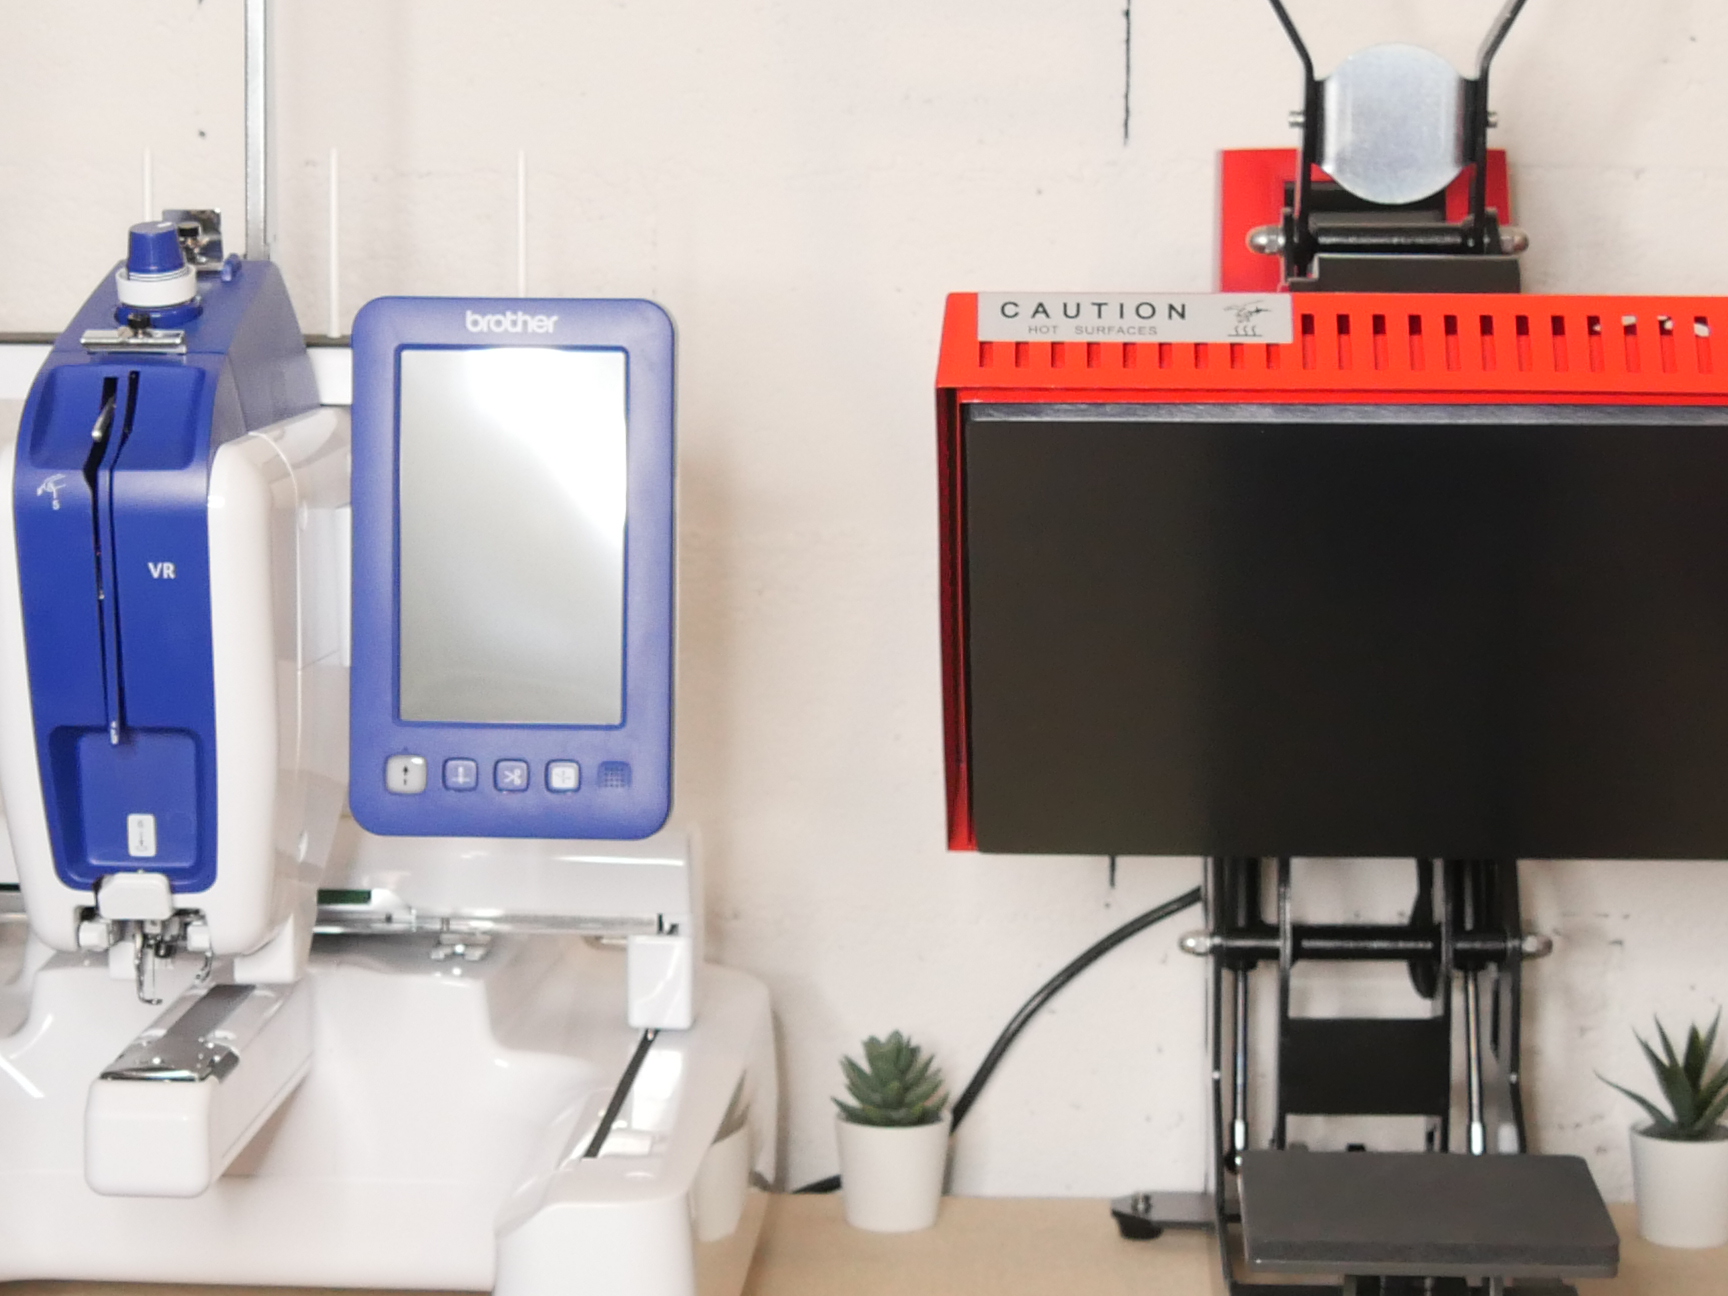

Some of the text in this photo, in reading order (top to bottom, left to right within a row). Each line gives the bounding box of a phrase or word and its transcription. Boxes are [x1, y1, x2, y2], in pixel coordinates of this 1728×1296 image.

[1000, 301, 1187, 320] CAUTION
[465, 310, 559, 333] brother
[1028, 323, 1158, 336] HOT SURFACES
[147, 562, 176, 579] VR
